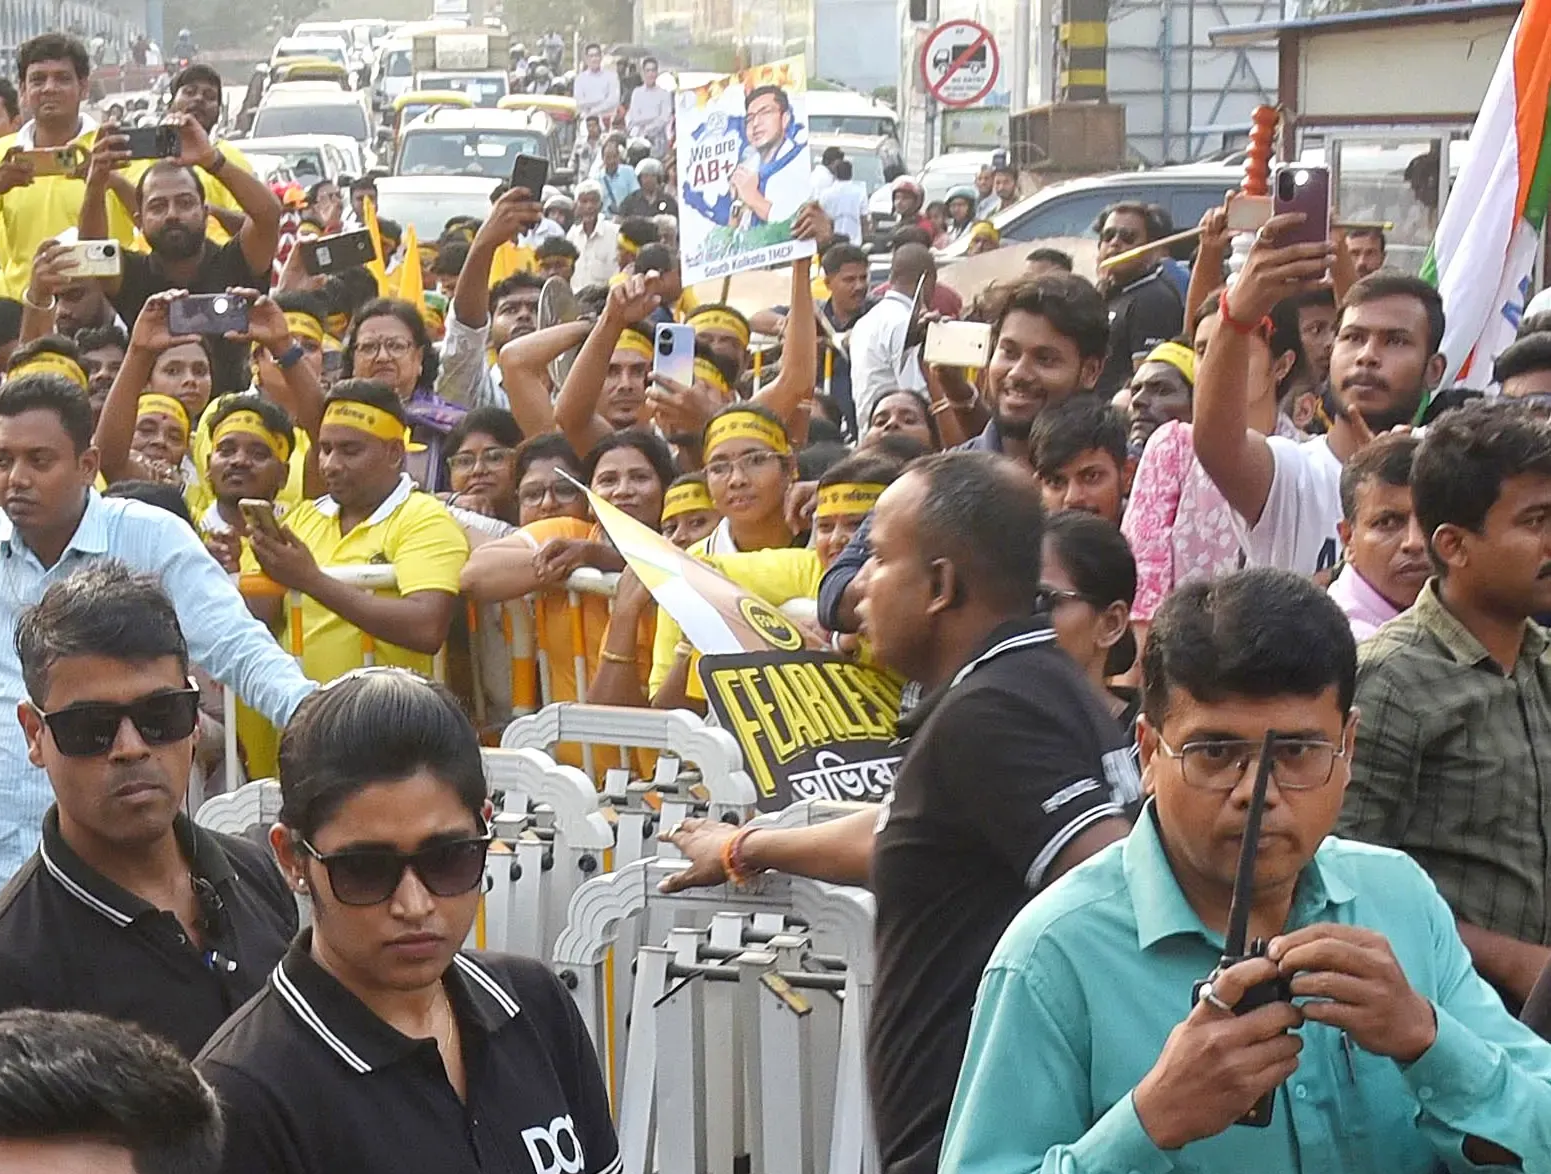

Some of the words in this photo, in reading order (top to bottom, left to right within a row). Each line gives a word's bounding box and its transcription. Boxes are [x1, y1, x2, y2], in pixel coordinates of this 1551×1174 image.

[690, 144, 712, 162] We
[715, 139, 736, 156] are
[693, 159, 735, 188] AB+
[704, 262, 730, 278] South
[731, 253, 767, 271] Kolkata
[768, 245, 794, 262] TMCP
[788, 750, 903, 801] অভিষে
